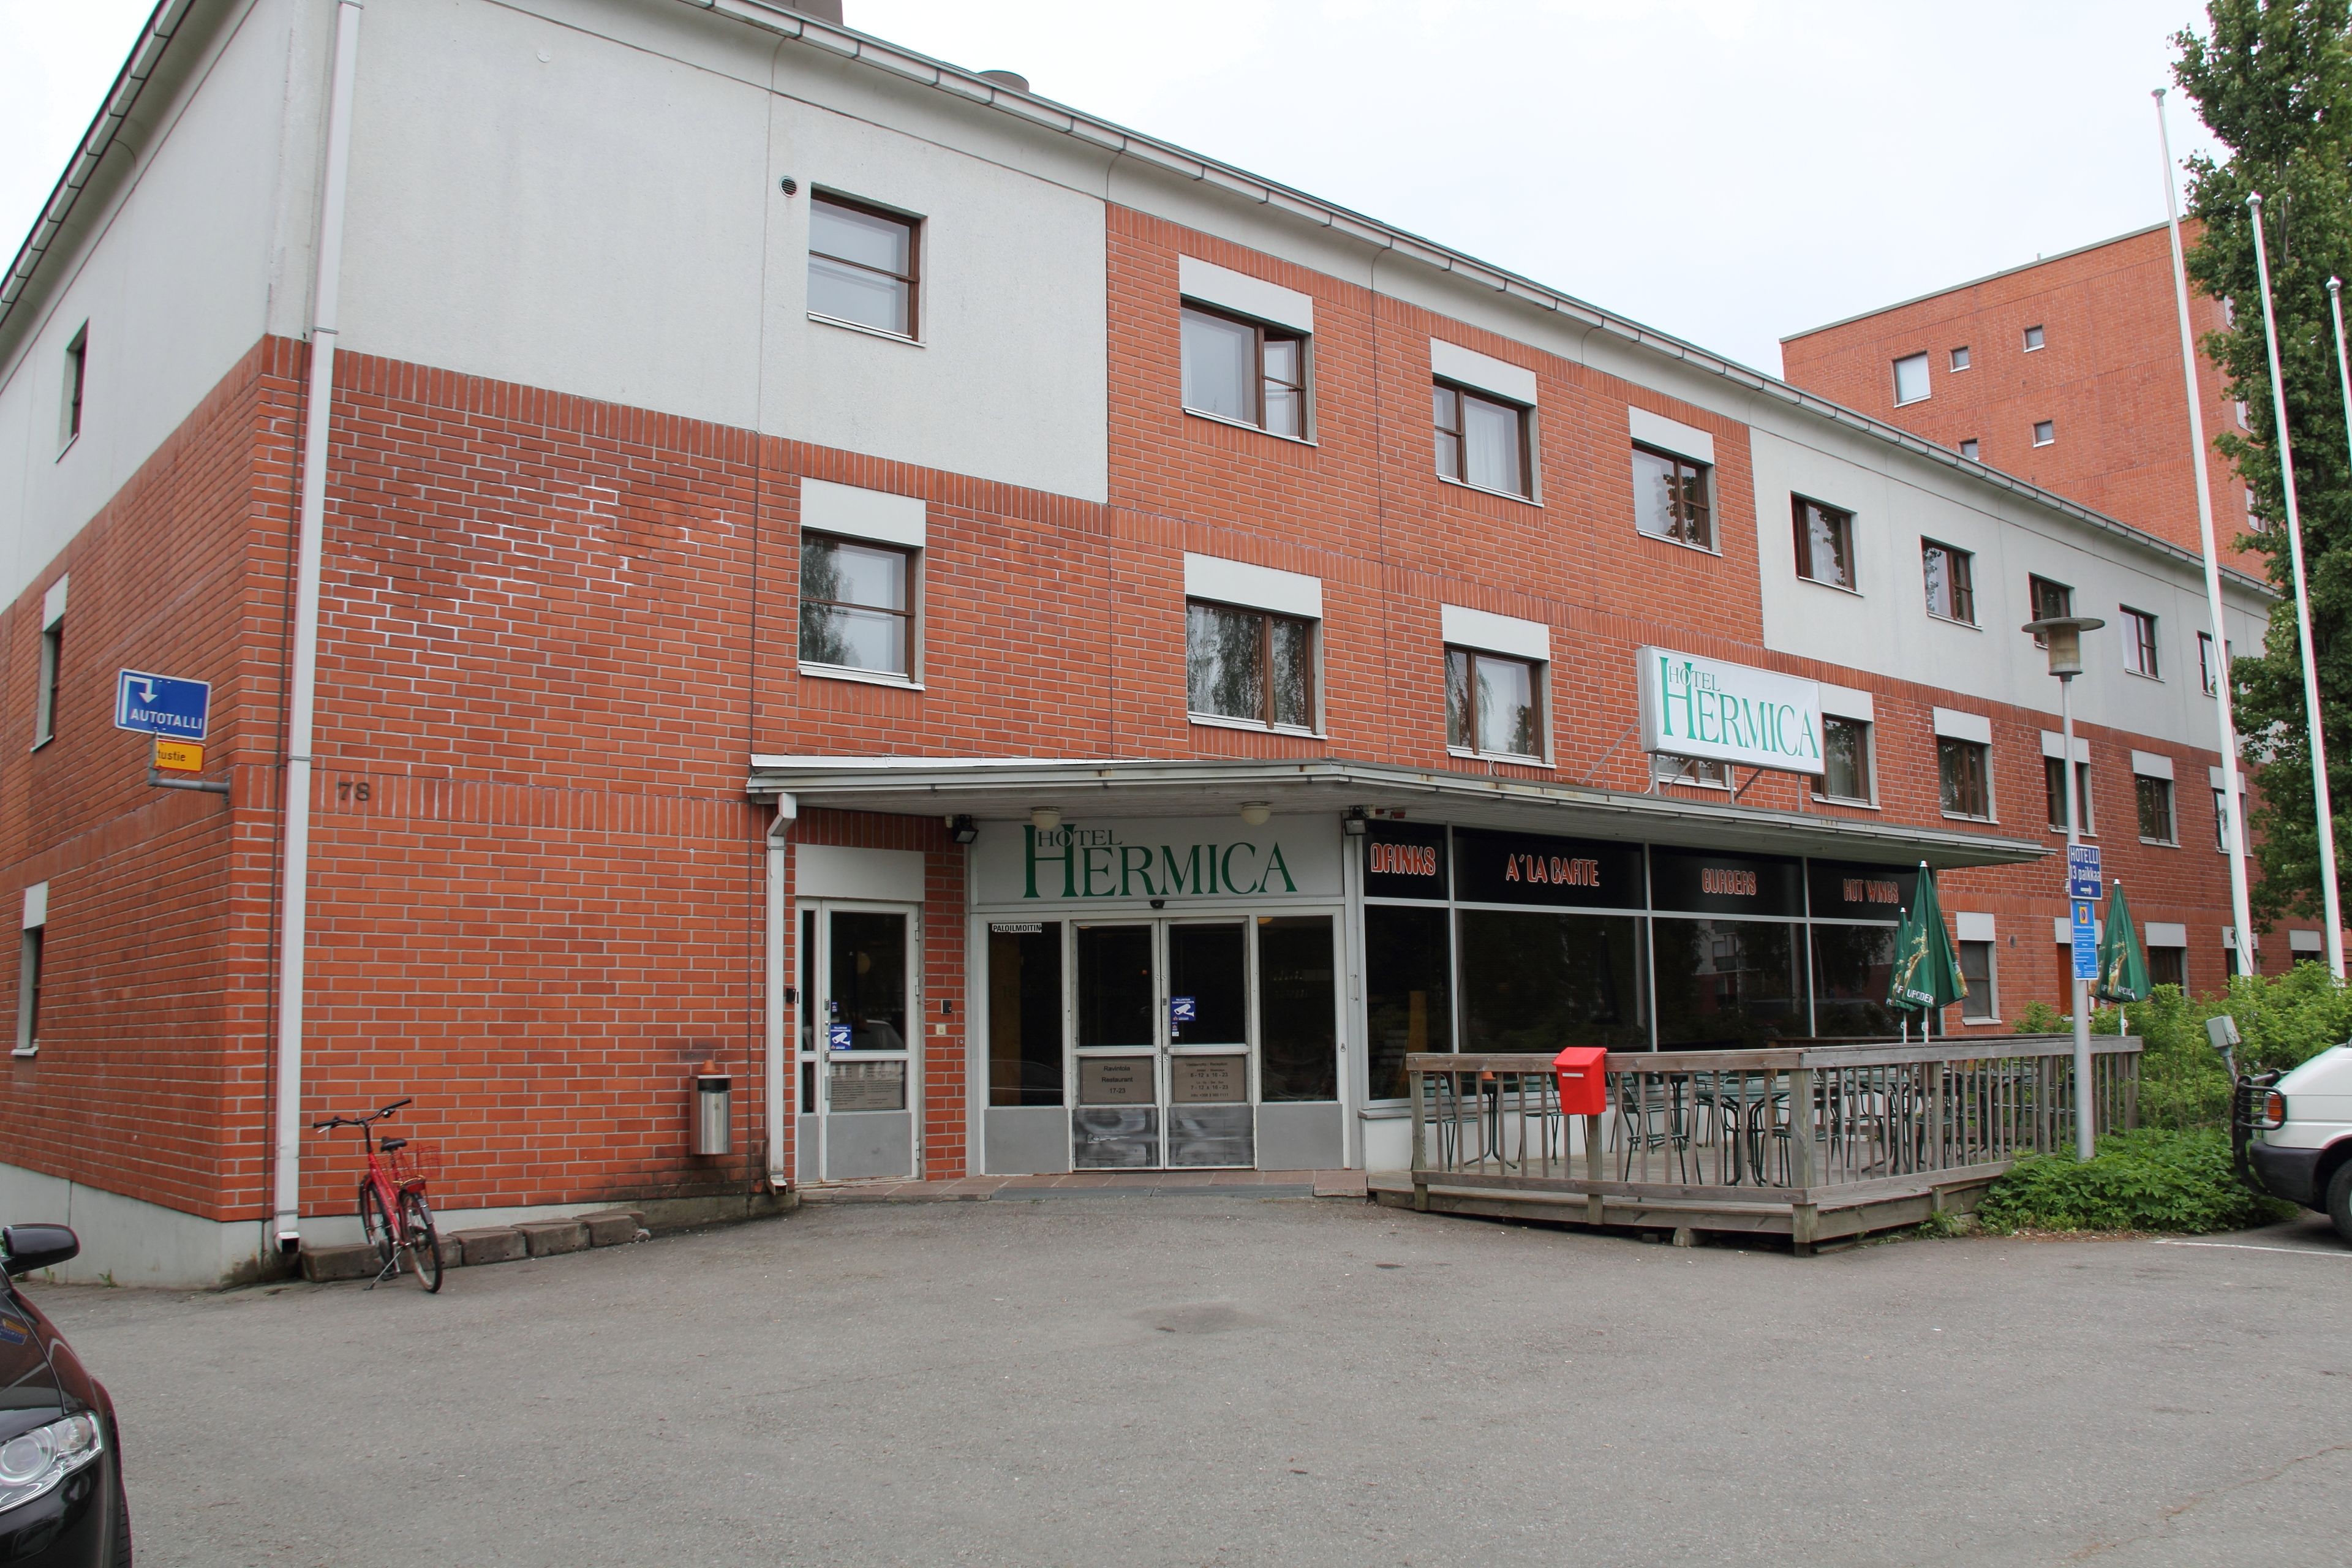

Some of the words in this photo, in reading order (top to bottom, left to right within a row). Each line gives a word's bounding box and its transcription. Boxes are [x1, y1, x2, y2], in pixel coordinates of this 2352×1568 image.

[1668, 666, 1721, 692] HOTEL
[130, 708, 203, 729] AUTOTALLI
[1659, 657, 1820, 760] HERMICA
[338, 782, 370, 801] 78
[1038, 829, 1123, 847] HOTEL
[1023, 824, 1298, 898] HERMICA
[1371, 843, 1436, 876] DRINKS
[2070, 847, 2098, 864] HOTELLI
[1550, 857, 1600, 886] CARTE
[1702, 868, 1757, 895] BURGERS
[2070, 865, 2076, 880] 13
[2078, 866, 2100, 883] paikkaa
[1843, 878, 1863, 902] HOT
[1865, 880, 1899, 903] WINGS
